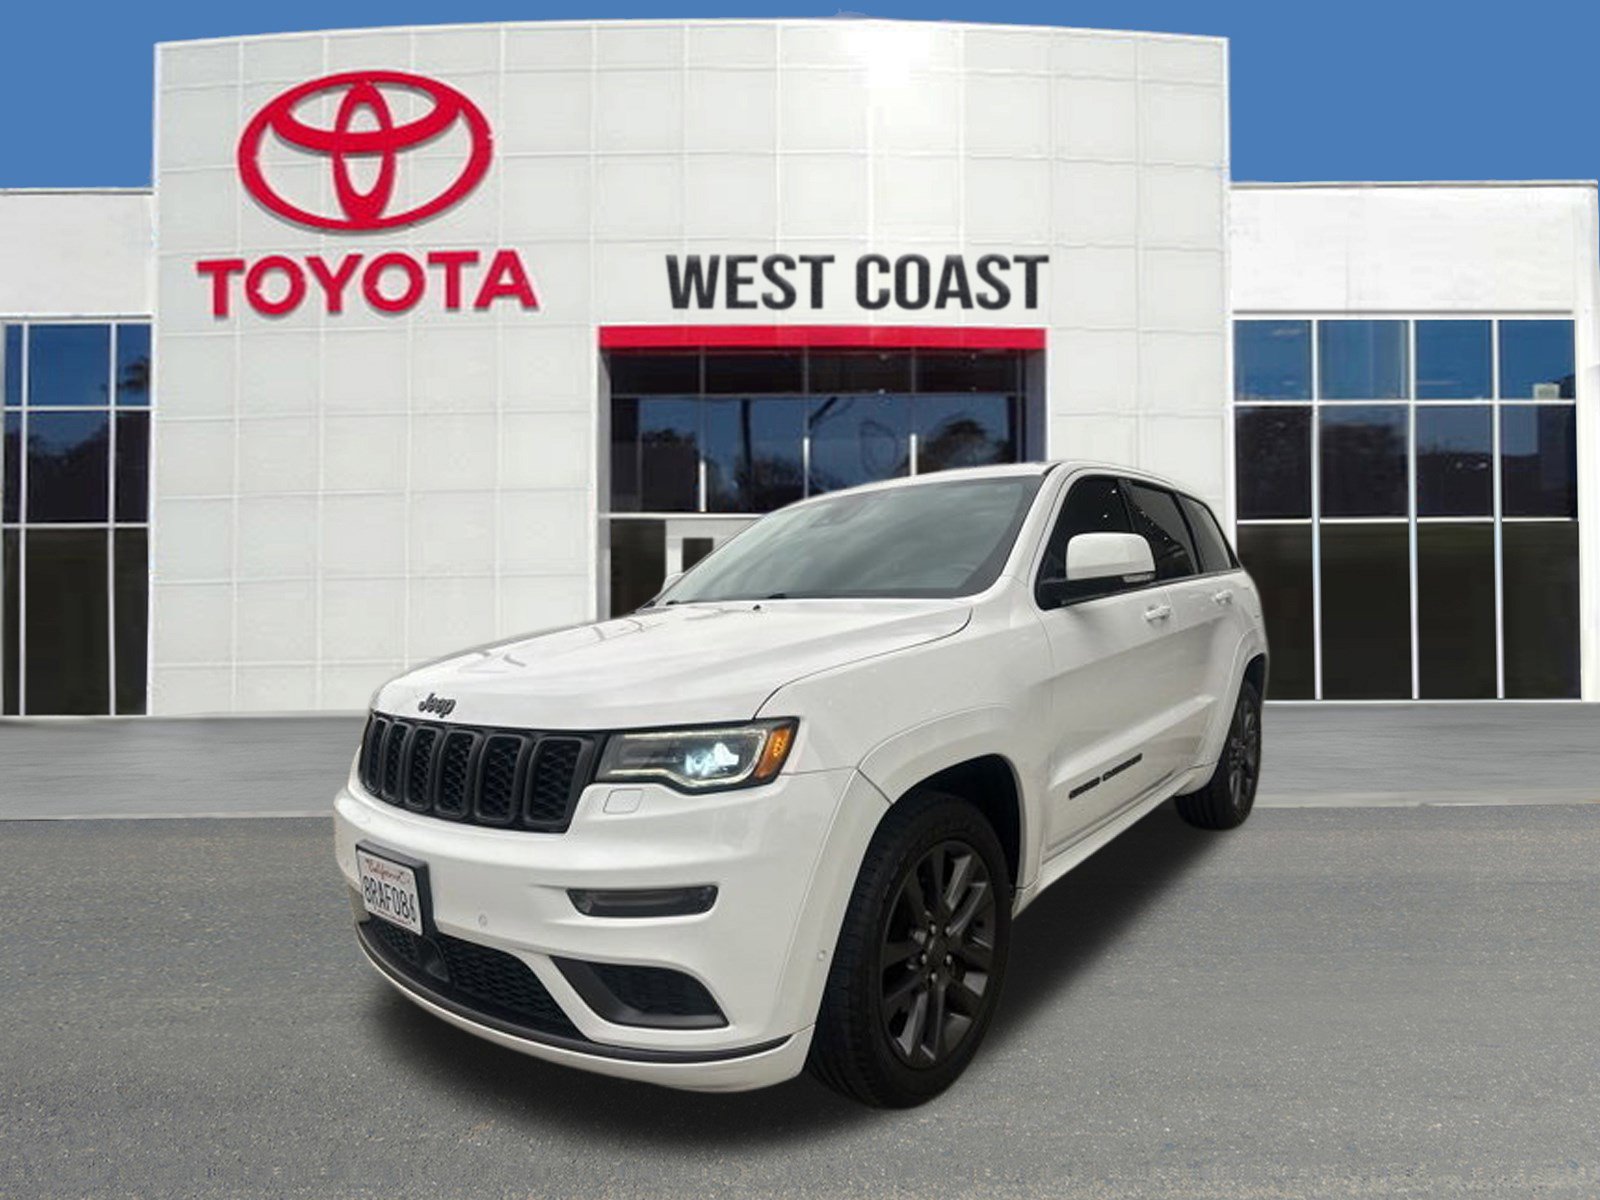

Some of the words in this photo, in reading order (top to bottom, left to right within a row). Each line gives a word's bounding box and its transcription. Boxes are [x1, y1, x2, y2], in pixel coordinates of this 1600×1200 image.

[196, 249, 538, 317] TOYOTA
[665, 253, 835, 310] WEST
[855, 253, 1050, 310] COAST
[418, 693, 456, 719] Jeep
